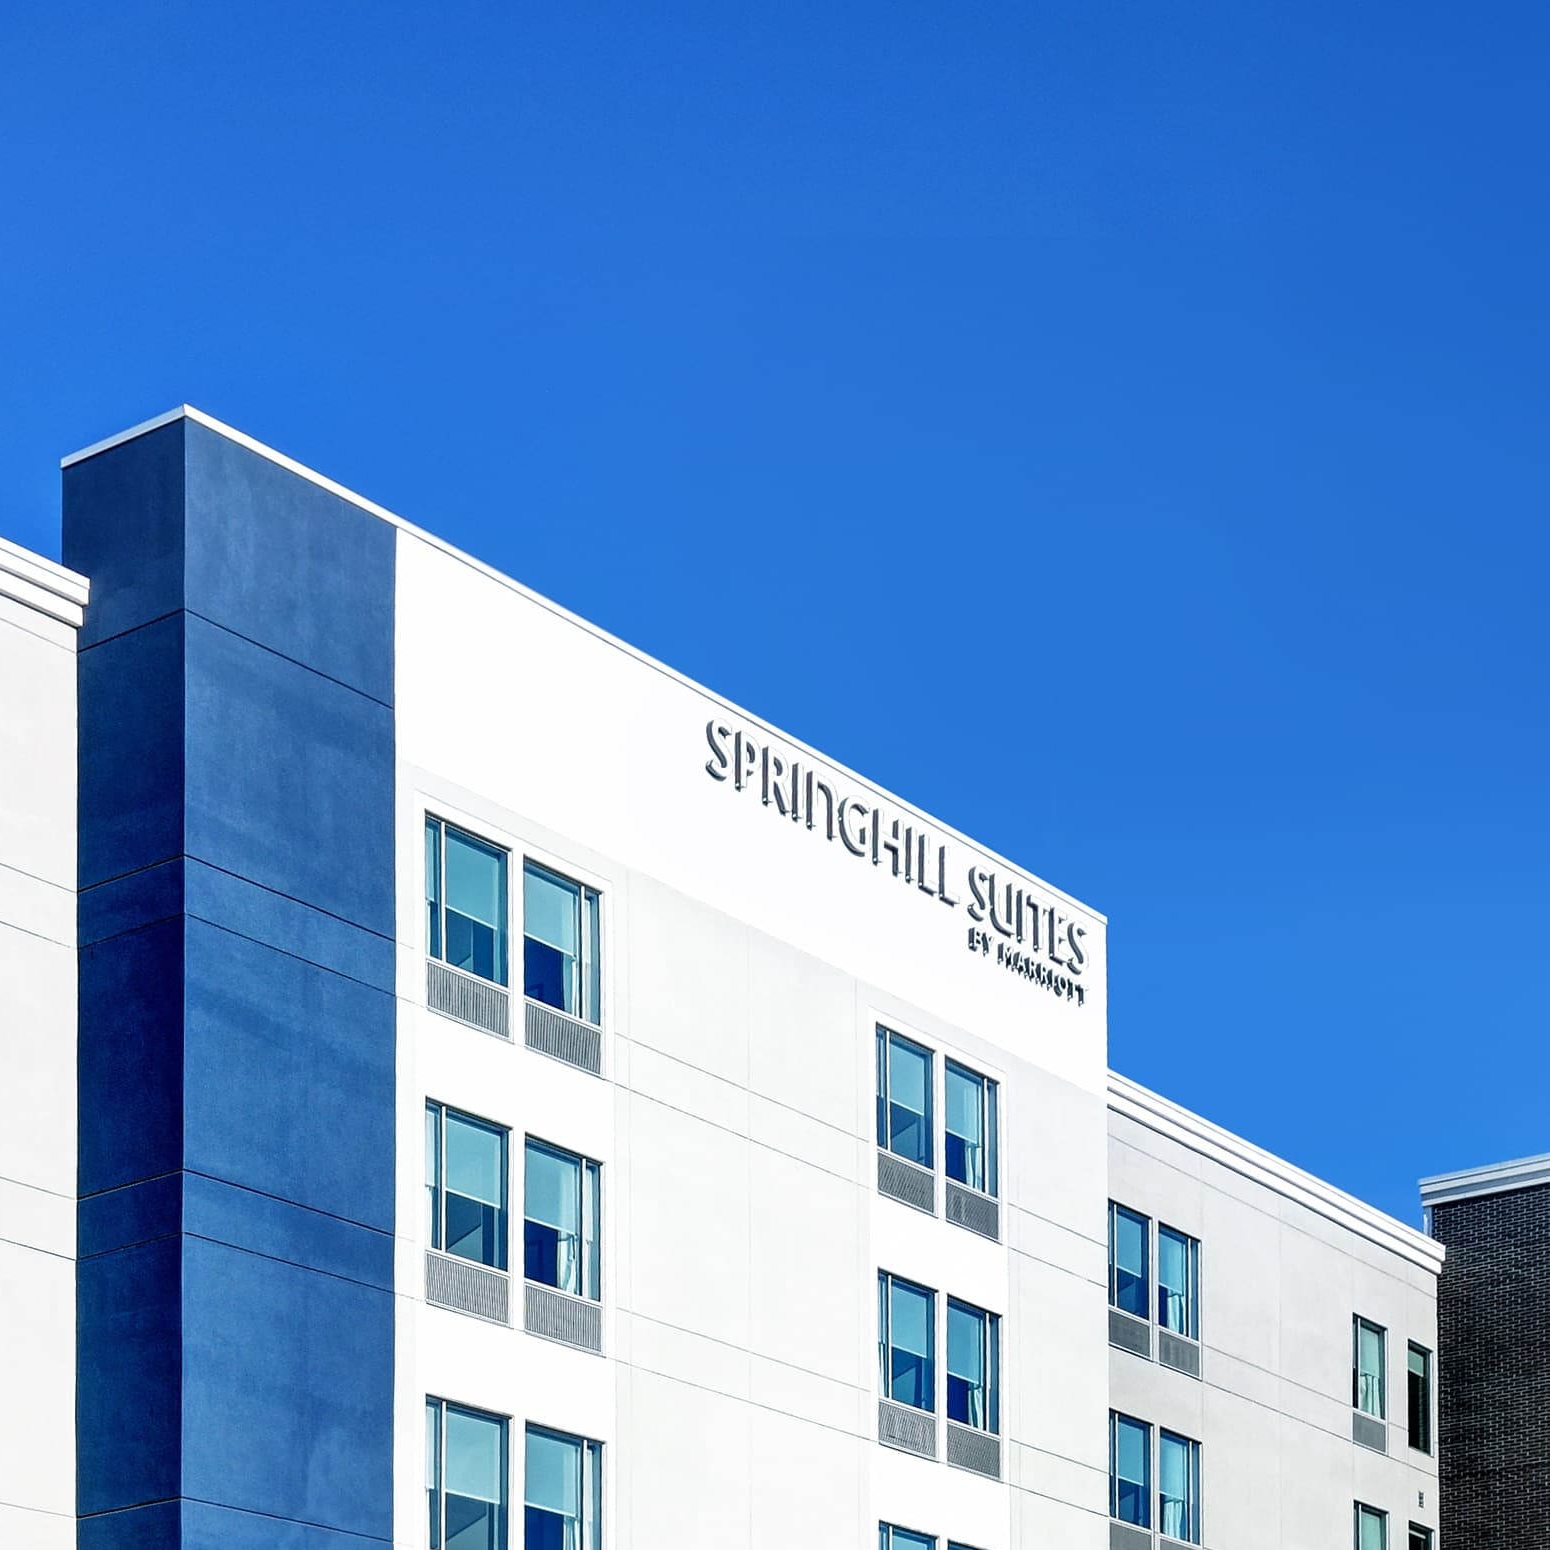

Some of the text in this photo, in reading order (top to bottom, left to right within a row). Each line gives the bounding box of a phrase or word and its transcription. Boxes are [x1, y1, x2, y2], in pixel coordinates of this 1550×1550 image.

[705, 717, 1090, 976] SPRINGHILL SUITES
[968, 926, 1089, 1007] BY MARRIOTT
